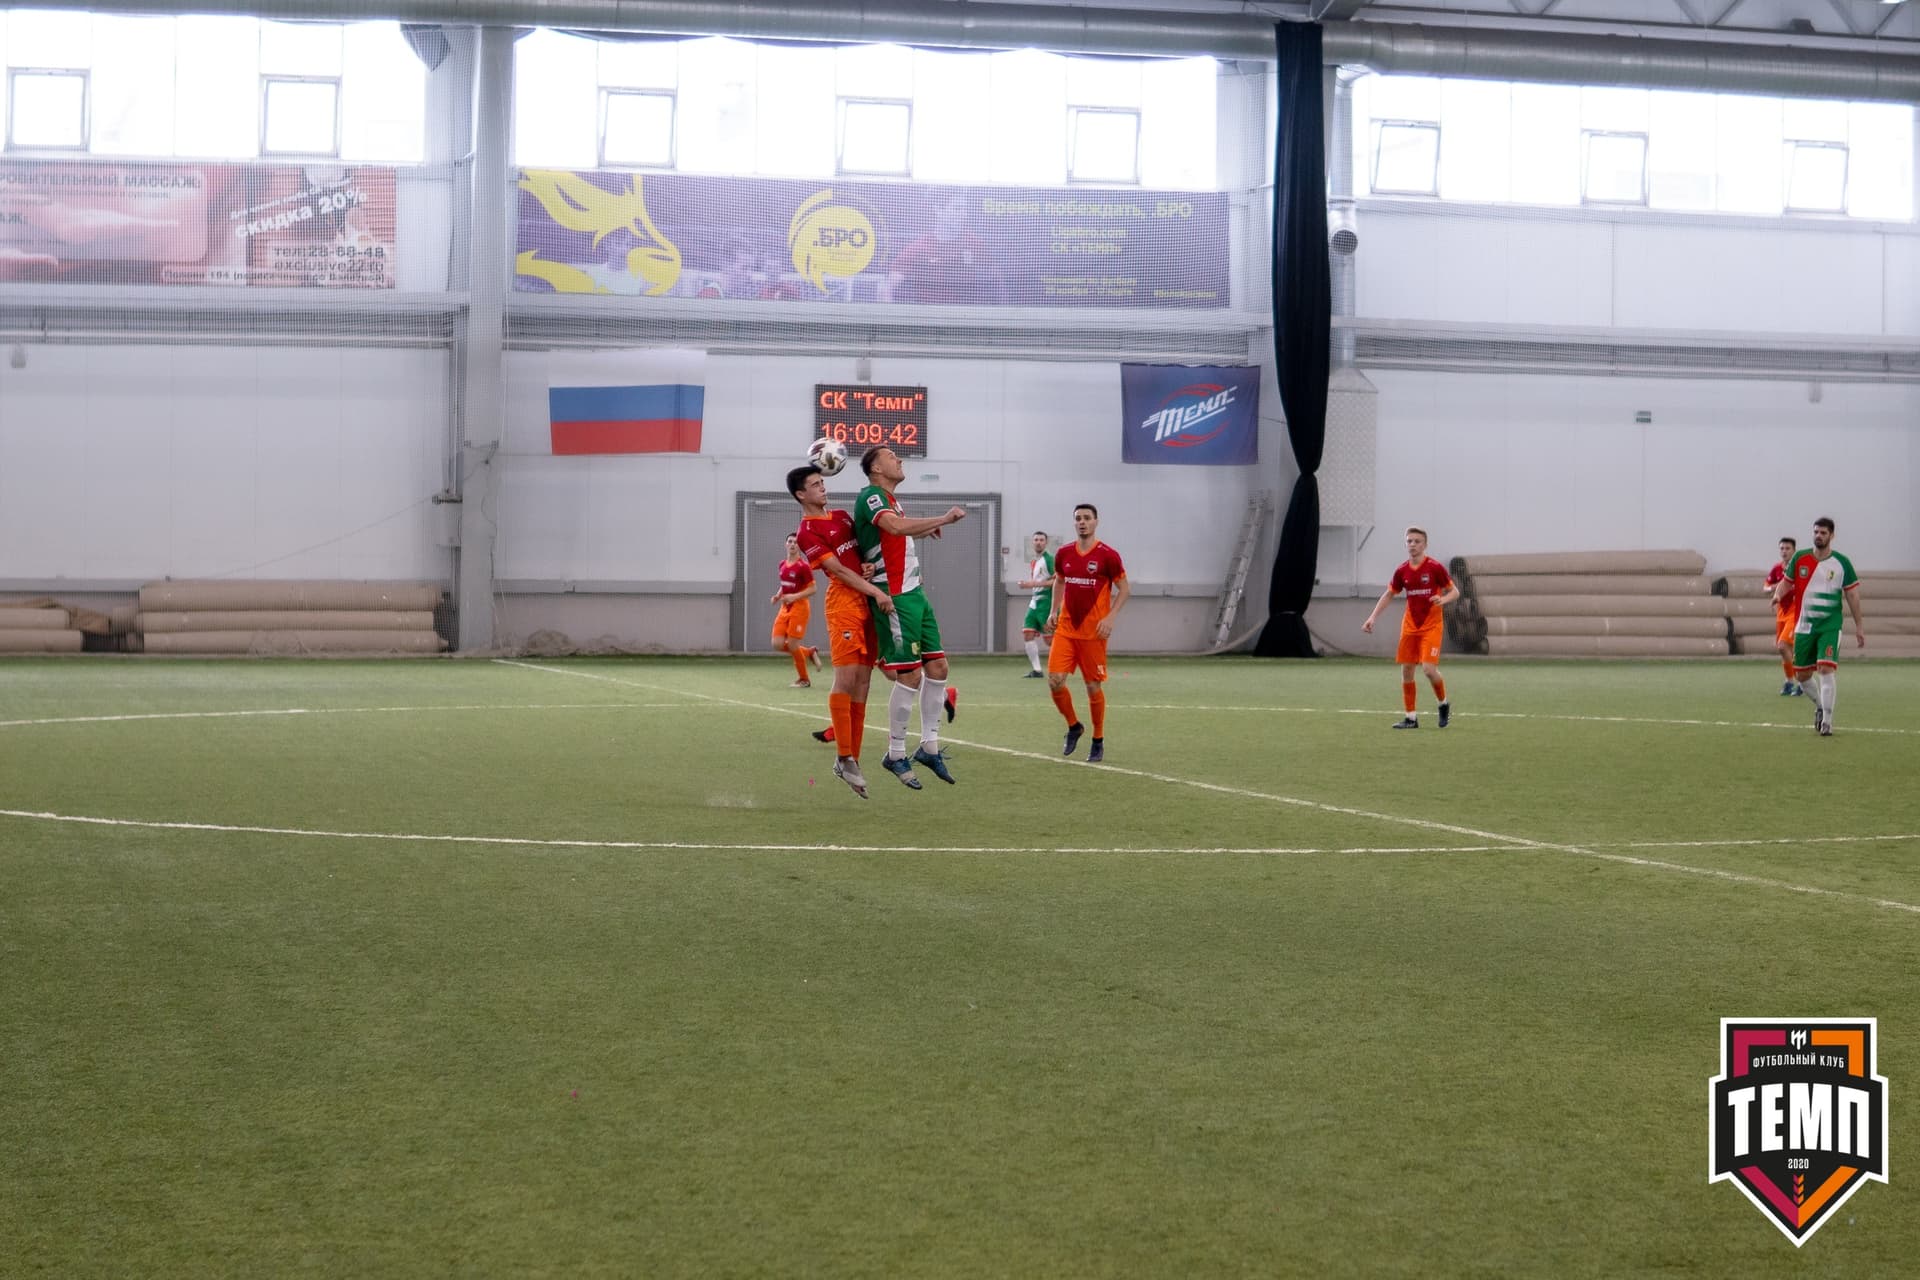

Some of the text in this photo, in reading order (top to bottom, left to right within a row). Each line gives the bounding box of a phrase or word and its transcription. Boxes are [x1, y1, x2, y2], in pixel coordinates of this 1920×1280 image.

[235, 186, 369, 238] скидка 20%
[983, 198, 1041, 217] Время
[812, 226, 868, 249] .БРО
[820, 391, 924, 411] СК "Темп"
[821, 422, 918, 446] 16:09:42
